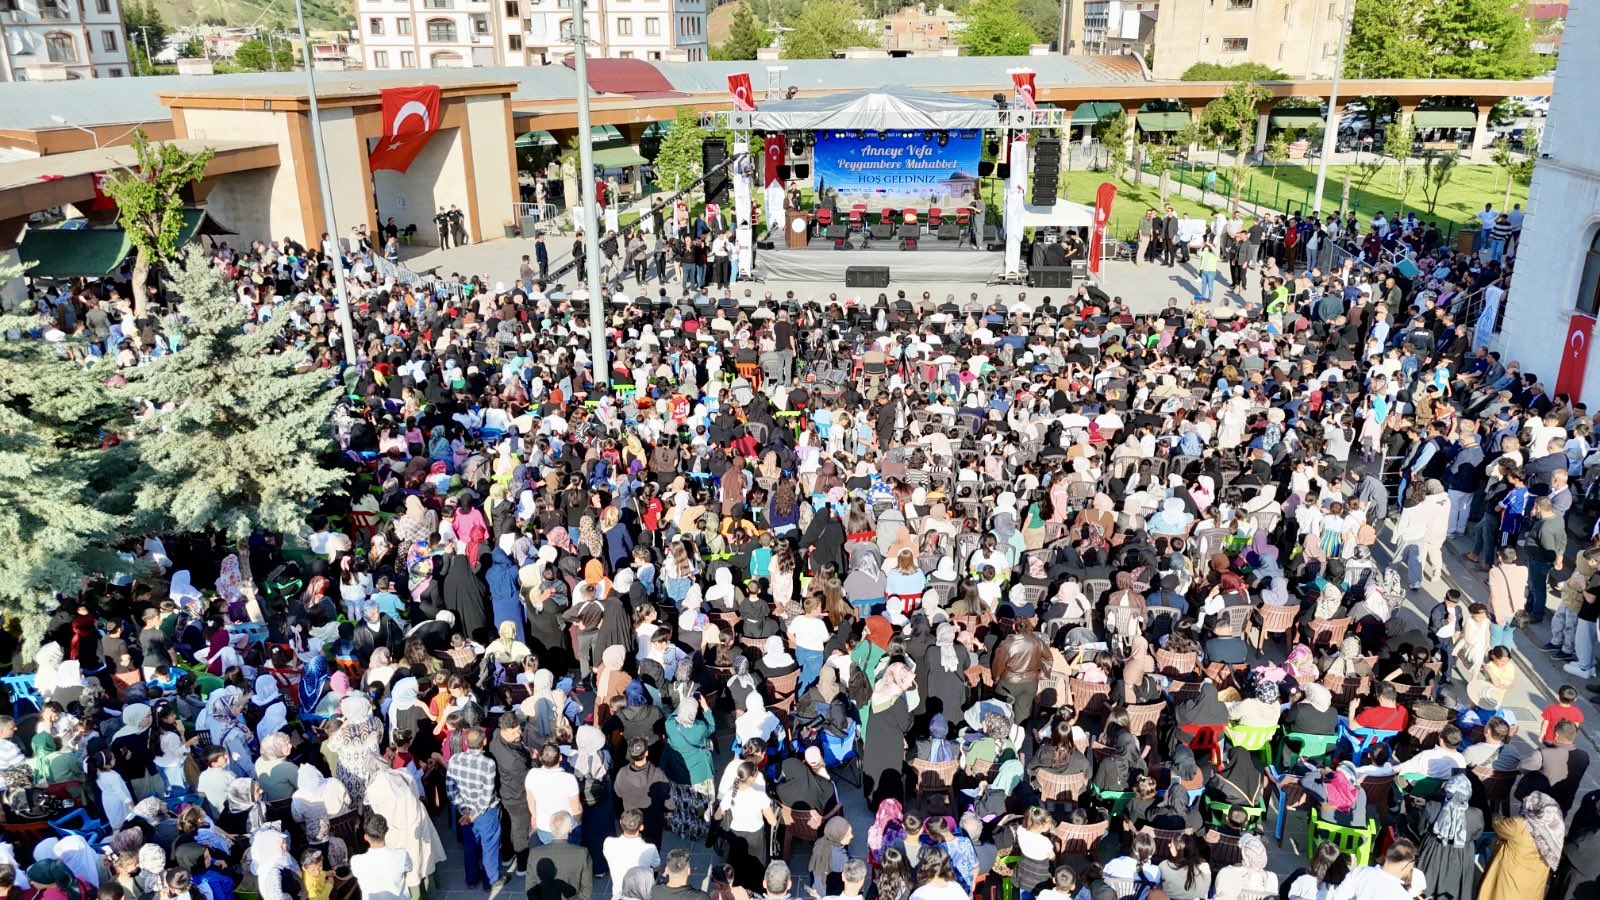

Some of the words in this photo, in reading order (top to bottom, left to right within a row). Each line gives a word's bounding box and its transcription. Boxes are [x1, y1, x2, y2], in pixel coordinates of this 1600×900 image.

[861, 145, 904, 159] Anneye
[906, 144, 933, 159] Vefa
[837, 159, 902, 171] Peygambere
[905, 158, 958, 169] Muhabbet
[858, 175, 880, 184] HOŞ
[883, 174, 936, 184] GELDİNİZ
